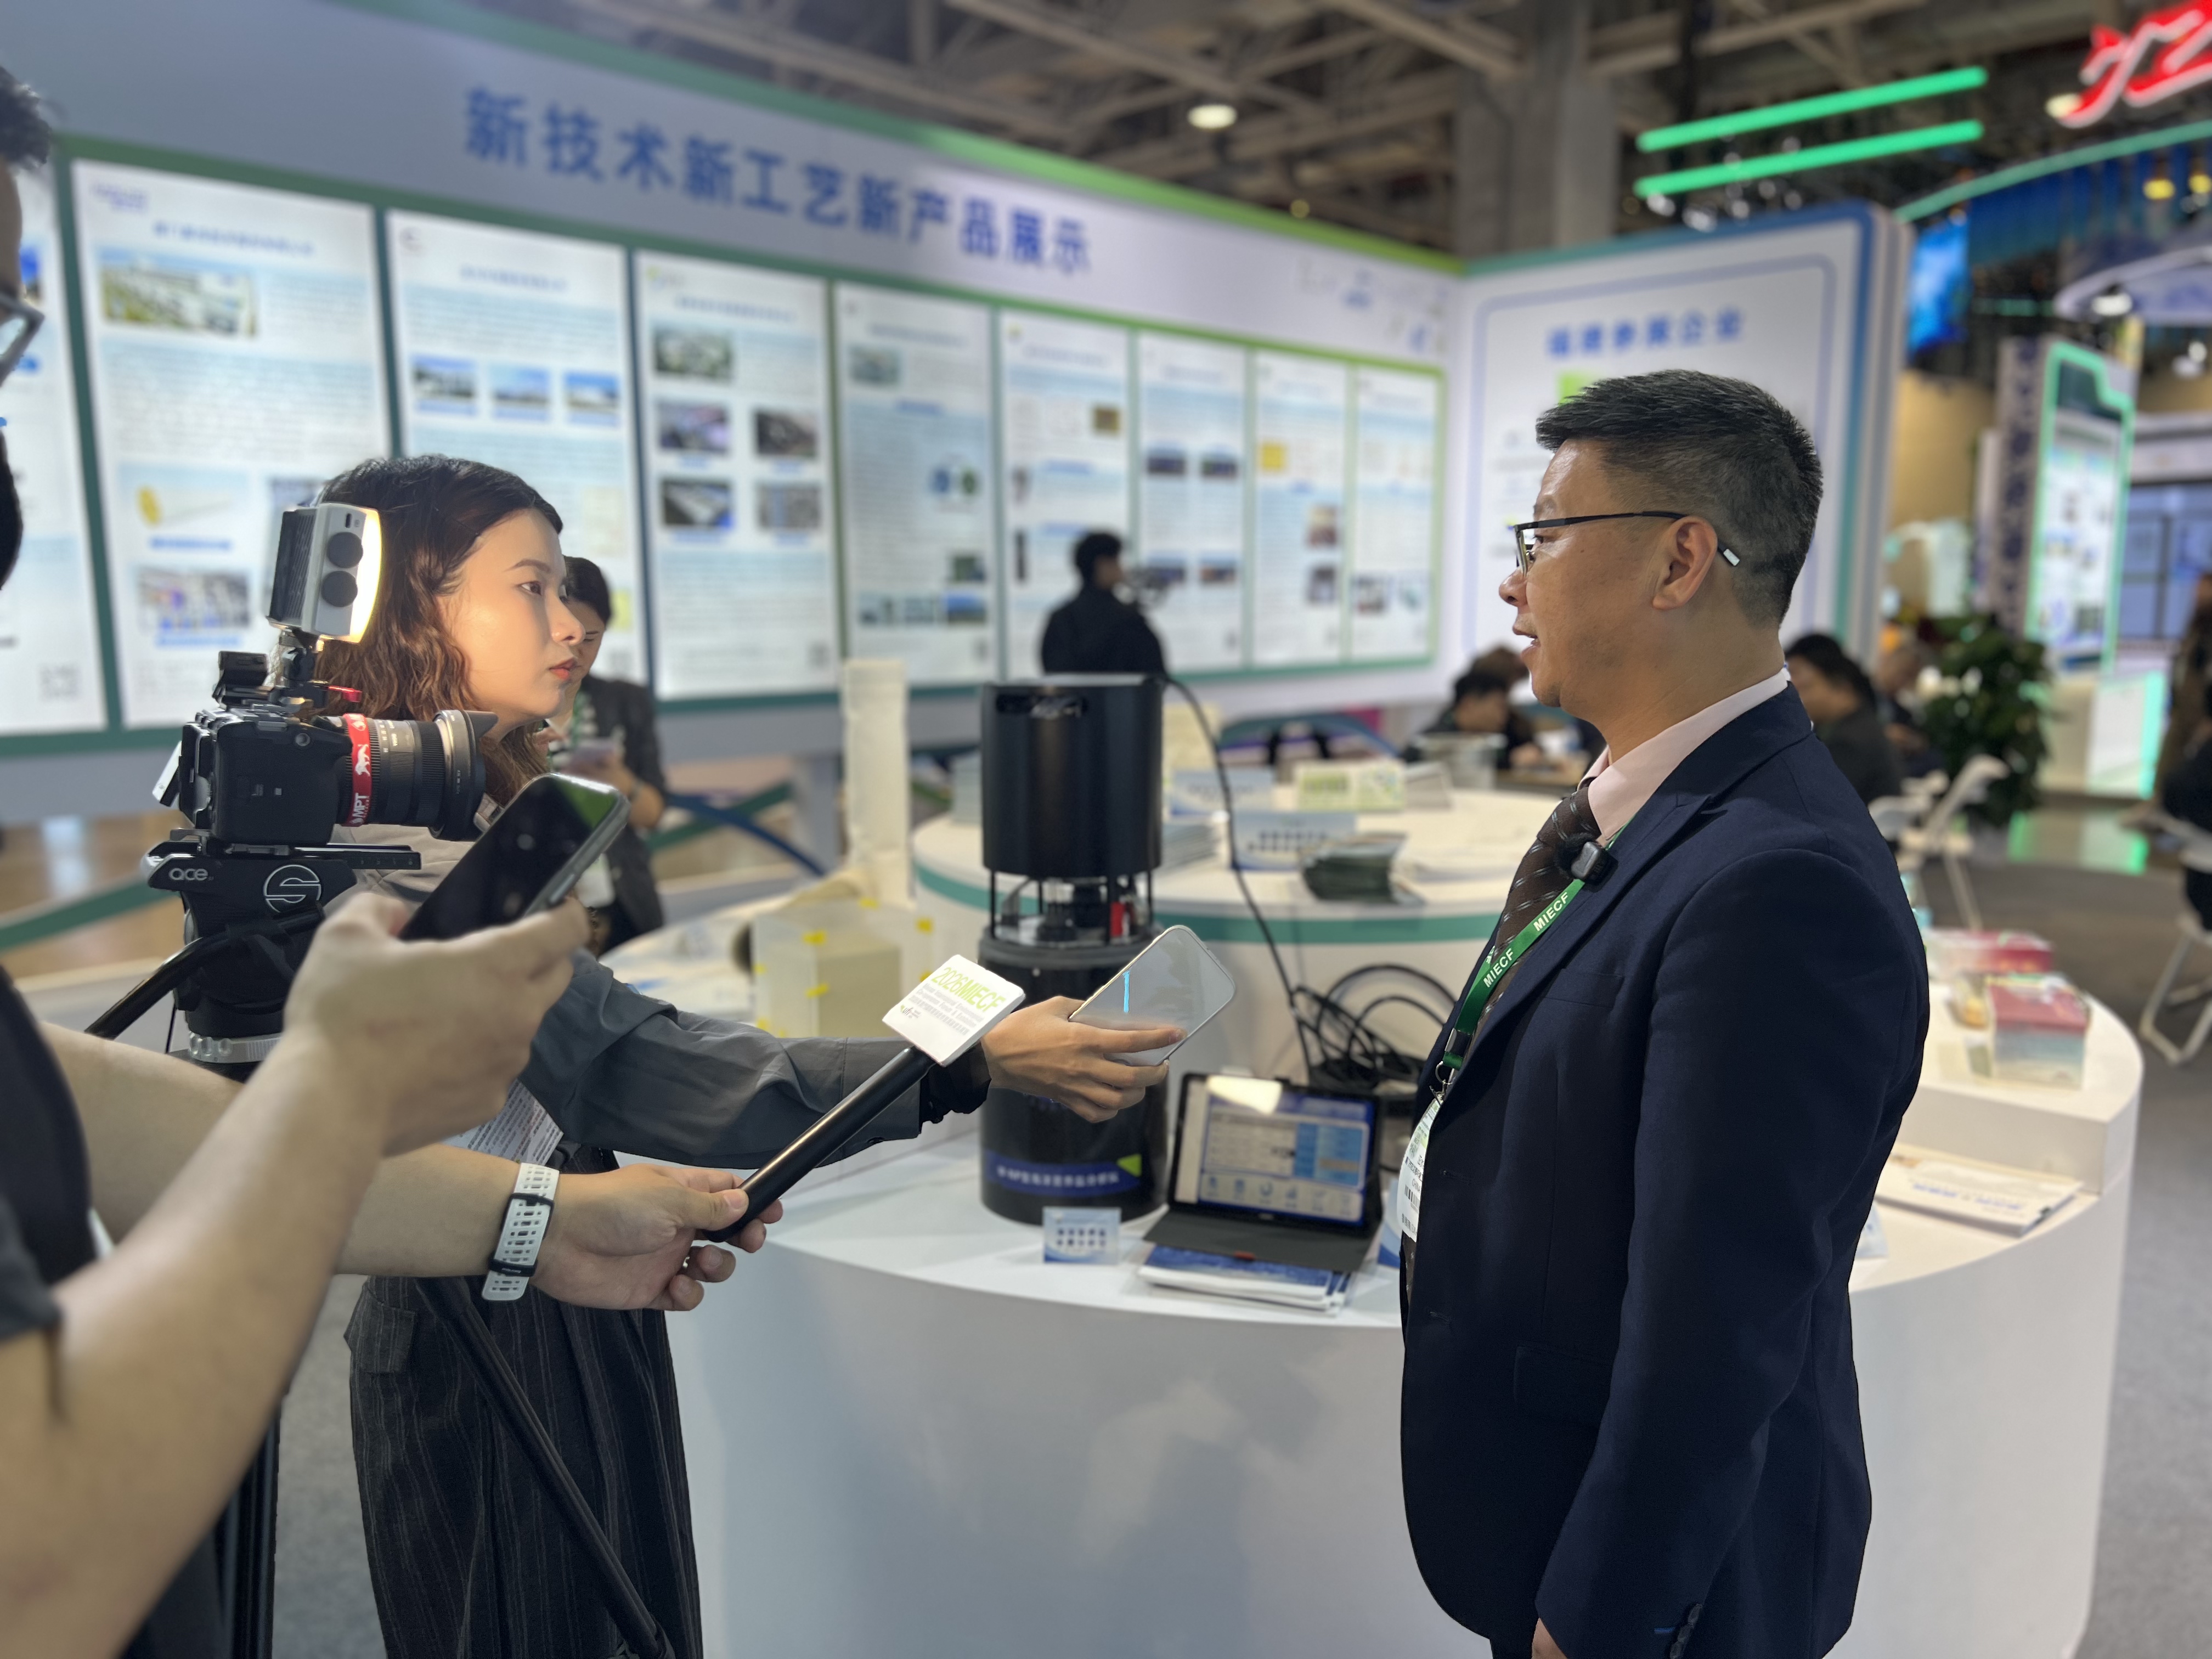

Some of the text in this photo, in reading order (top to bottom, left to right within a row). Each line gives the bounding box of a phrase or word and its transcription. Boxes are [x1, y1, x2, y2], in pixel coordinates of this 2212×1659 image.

[464, 88, 1092, 274] 新技术新工艺新产品展示
[352, 792, 368, 818] MPT
[168, 868, 208, 881] ace
[1533, 892, 1568, 931] MIECF
[1483, 948, 1513, 988] MIECF
[931, 967, 1006, 1013] 2026MIECF
